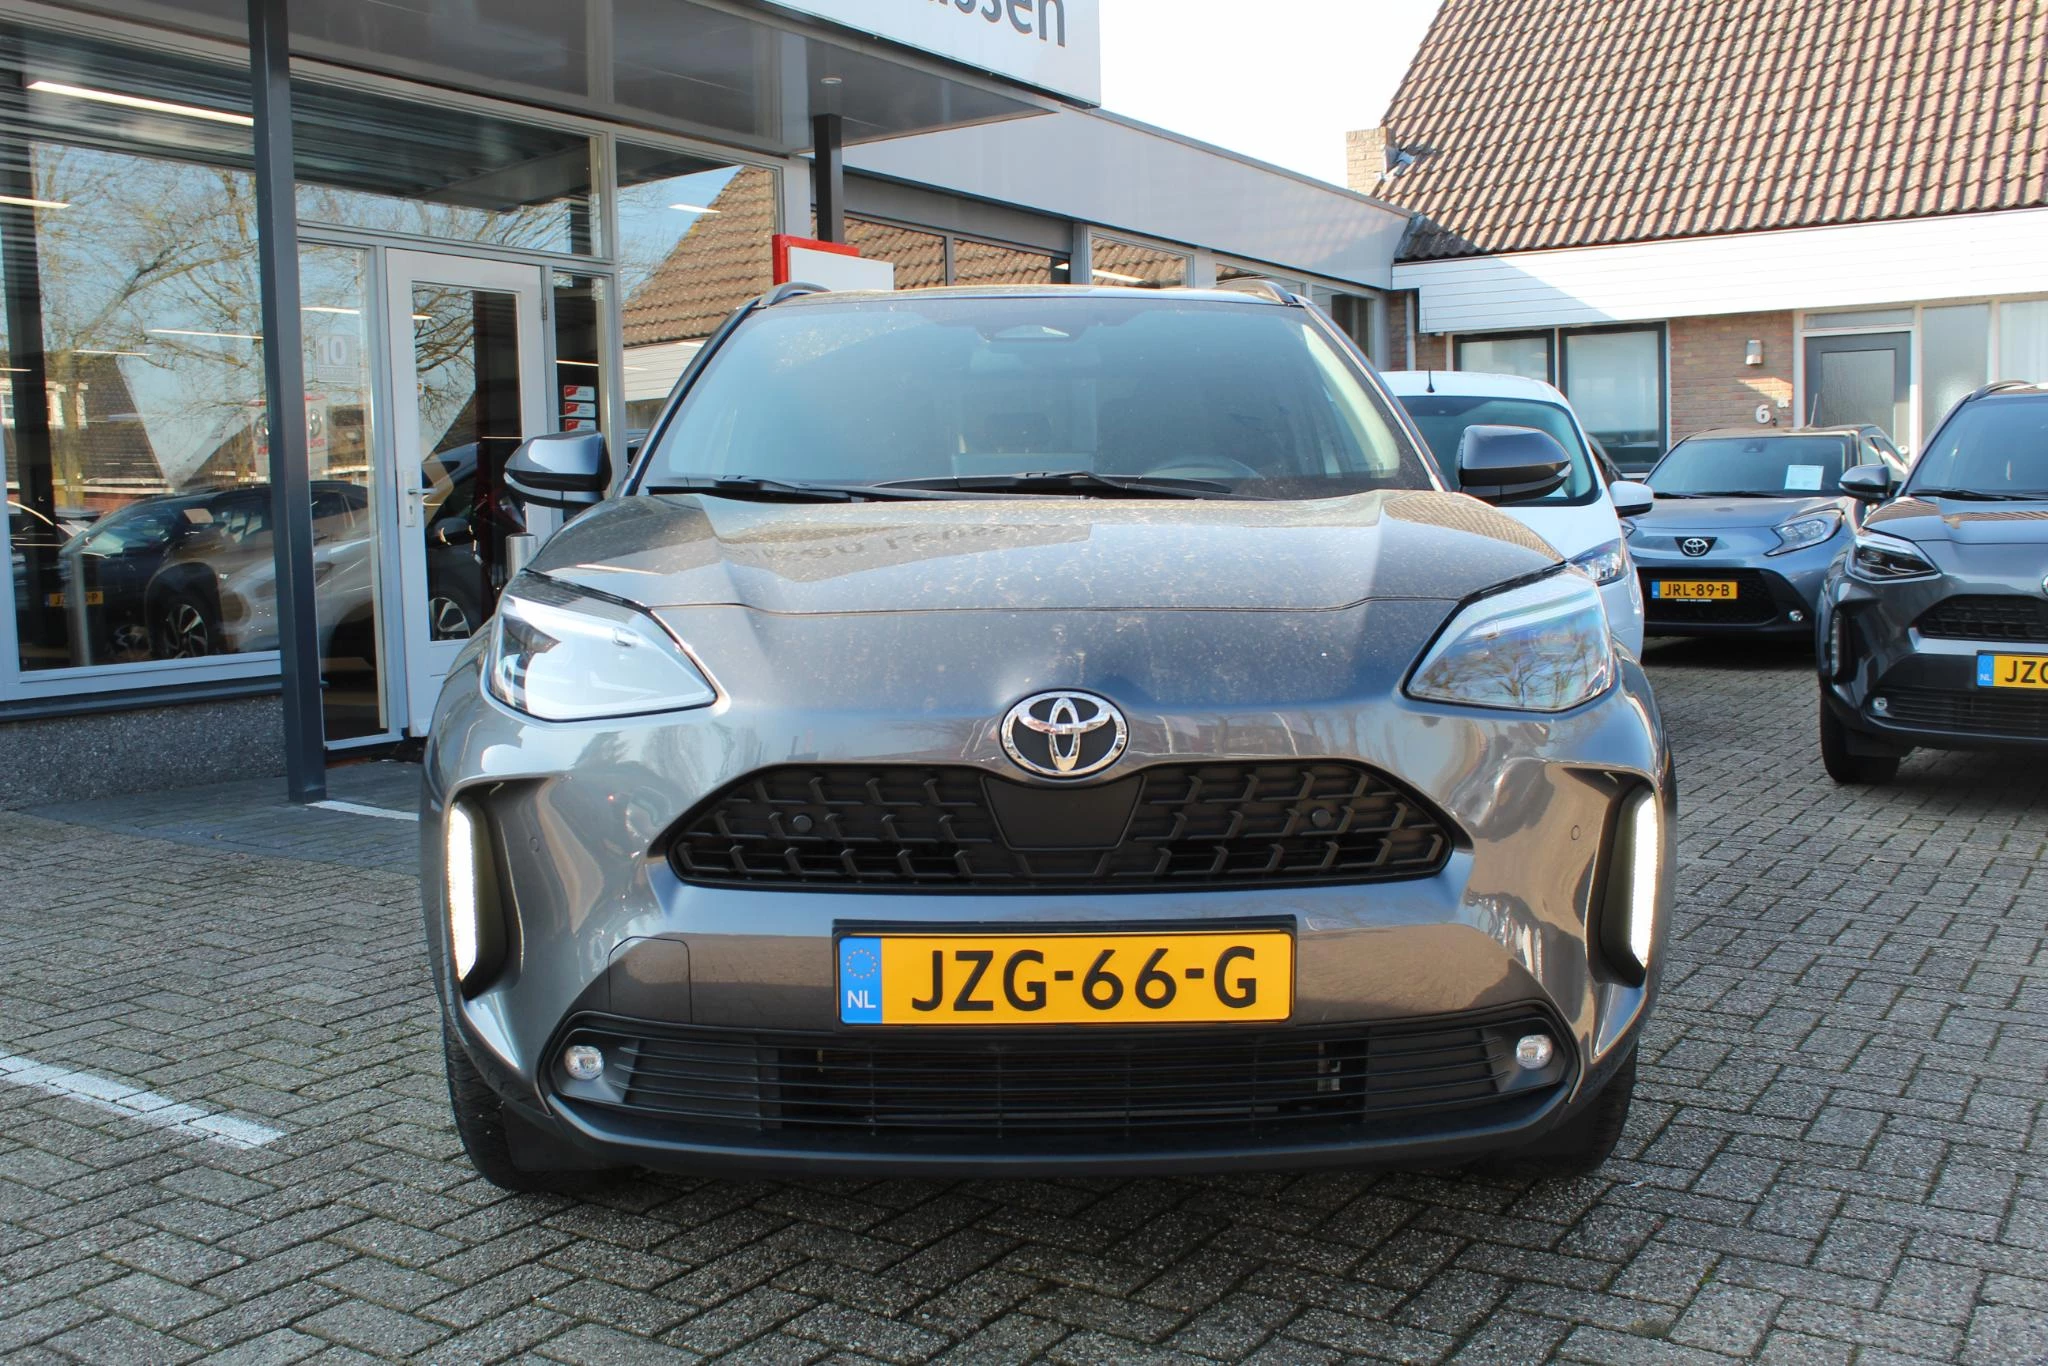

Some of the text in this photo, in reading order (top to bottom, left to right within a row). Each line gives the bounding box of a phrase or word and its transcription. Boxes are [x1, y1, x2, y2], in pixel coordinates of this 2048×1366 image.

[1755, 404, 1770, 424] 6
[1664, 583, 1730, 597] JRL-89-B
[911, 945, 1257, 1012] JZG-66-G
[847, 990, 876, 1009] NL
